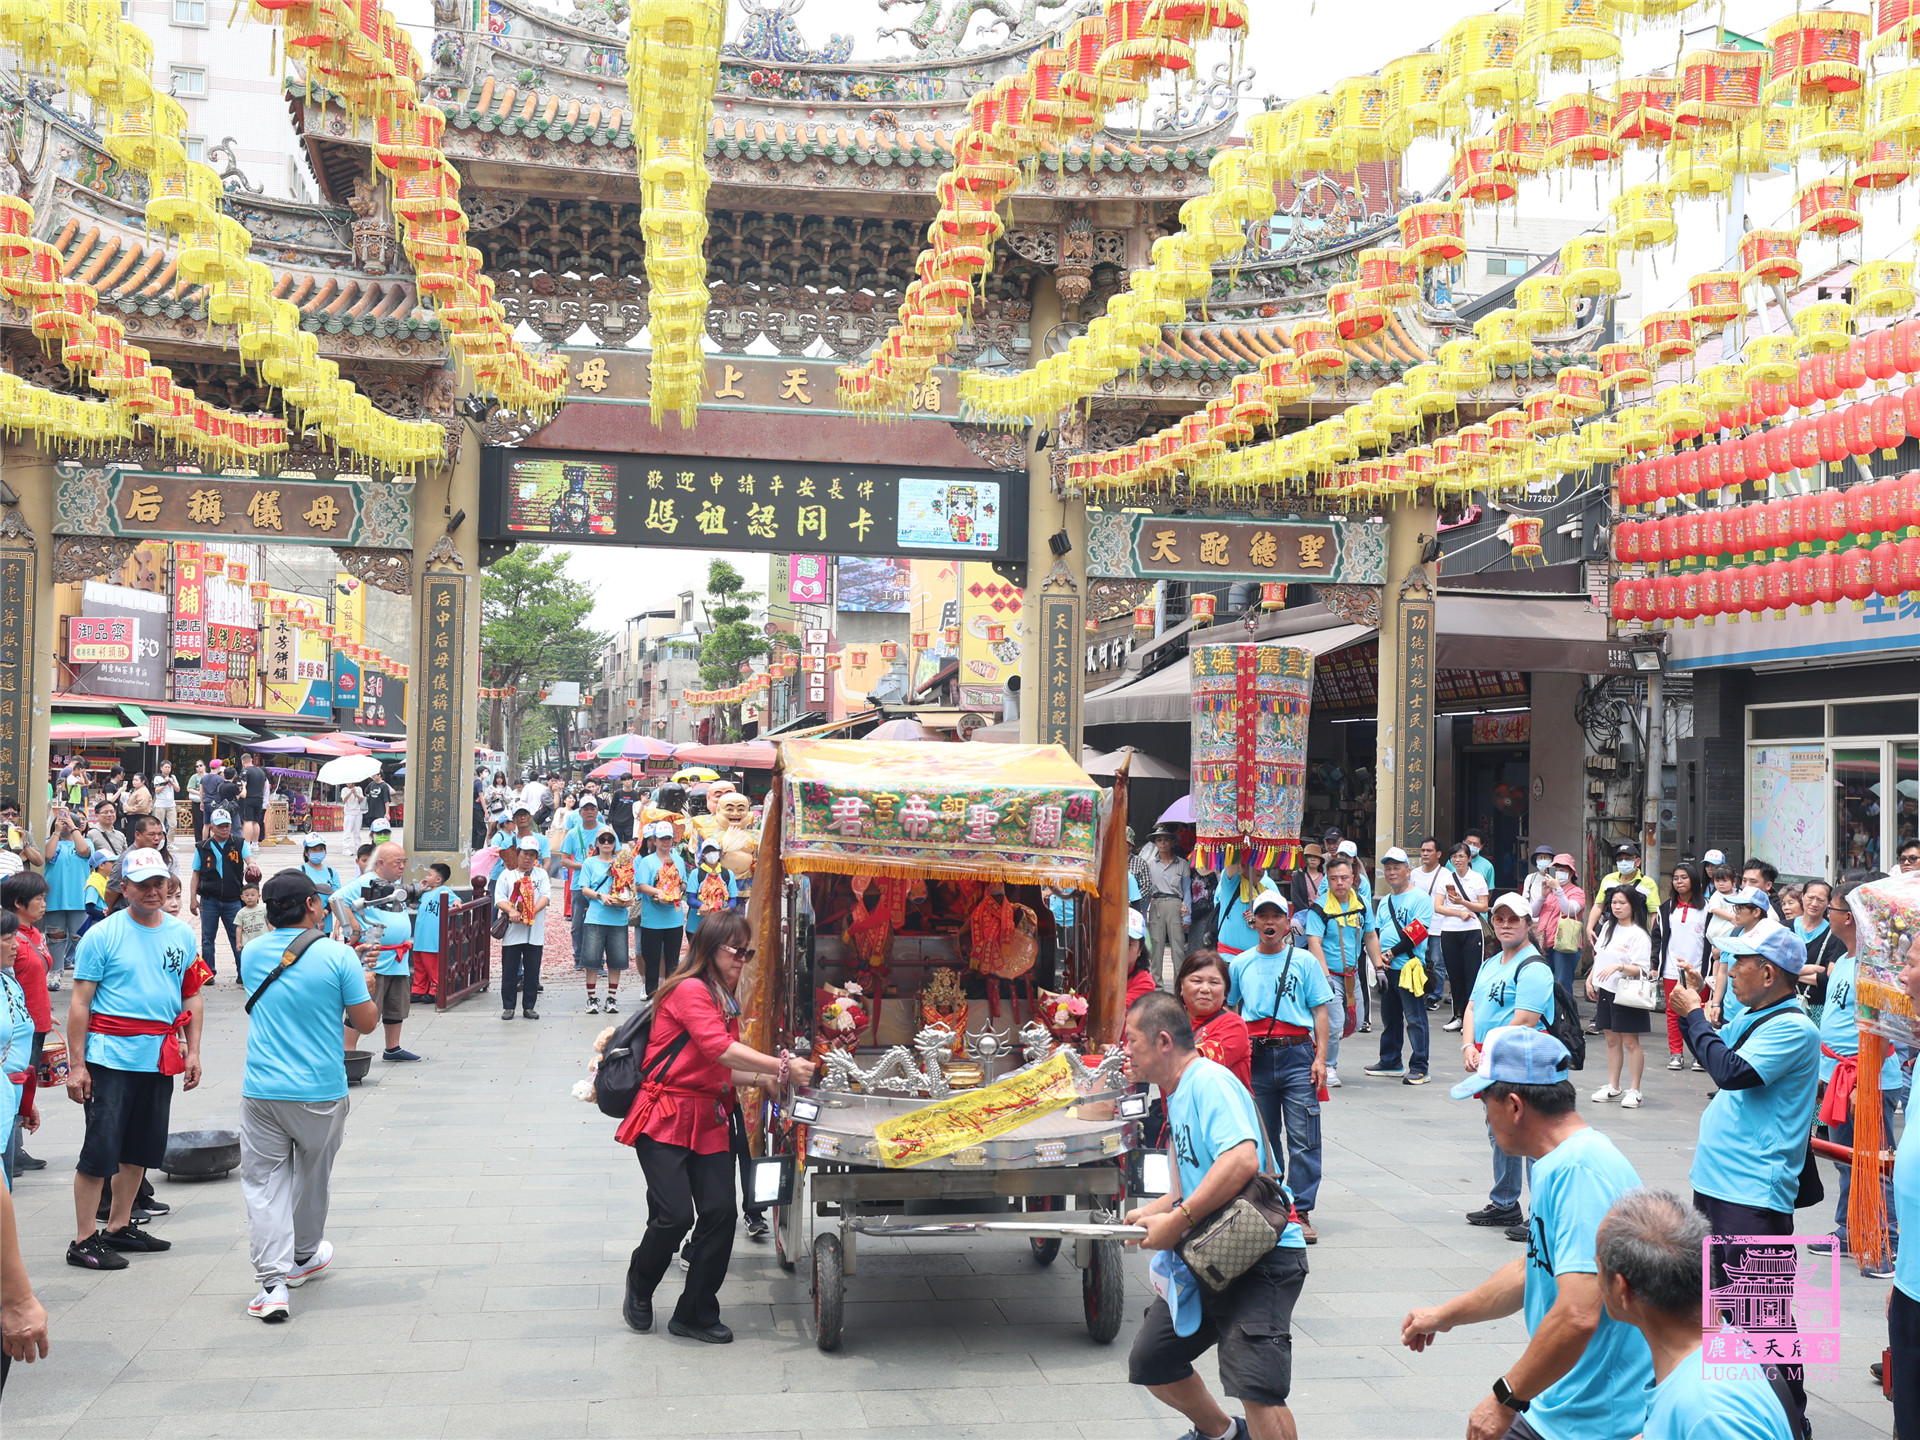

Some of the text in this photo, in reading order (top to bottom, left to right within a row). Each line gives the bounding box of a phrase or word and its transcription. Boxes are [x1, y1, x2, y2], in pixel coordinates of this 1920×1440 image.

[646, 469, 875, 502] 歡迎申請平安長伴
[644, 498, 877, 543] 媽祖認同卡
[77, 622, 126, 641] 御品齋
[175, 619, 201, 632] 總店
[174, 634, 201, 648] 百年老店
